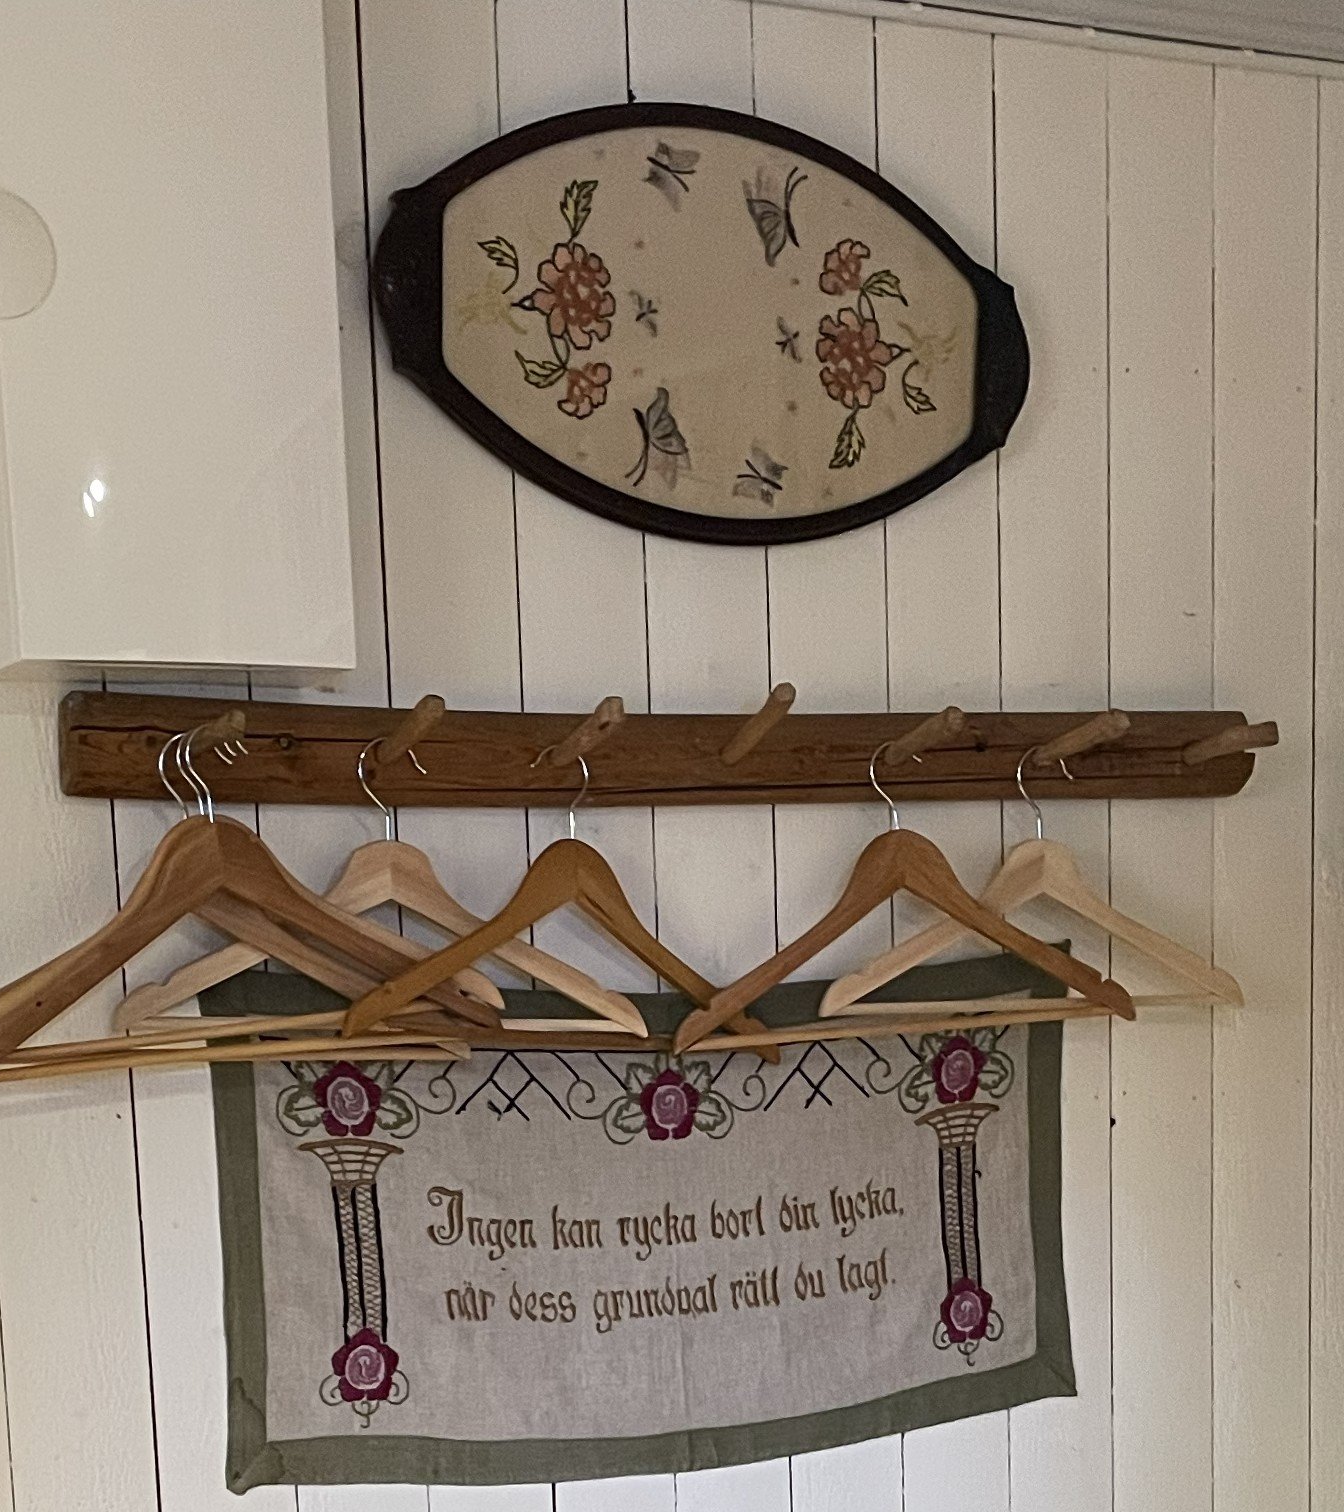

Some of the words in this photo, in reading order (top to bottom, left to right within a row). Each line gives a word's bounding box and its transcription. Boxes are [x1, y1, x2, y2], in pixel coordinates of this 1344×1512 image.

[427, 1185, 538, 1260] Ingen
[551, 1204, 605, 1250] kan
[616, 1202, 697, 1261] rycka
[710, 1196, 768, 1241] bort
[778, 1193, 821, 1234] din
[829, 1178, 905, 1237] lycka,
[444, 1280, 497, 1322] när
[508, 1280, 577, 1324] dess
[592, 1273, 719, 1334] grundval
[729, 1264, 782, 1311] rätt
[793, 1260, 826, 1300] du
[837, 1247, 897, 1301] lagt.
